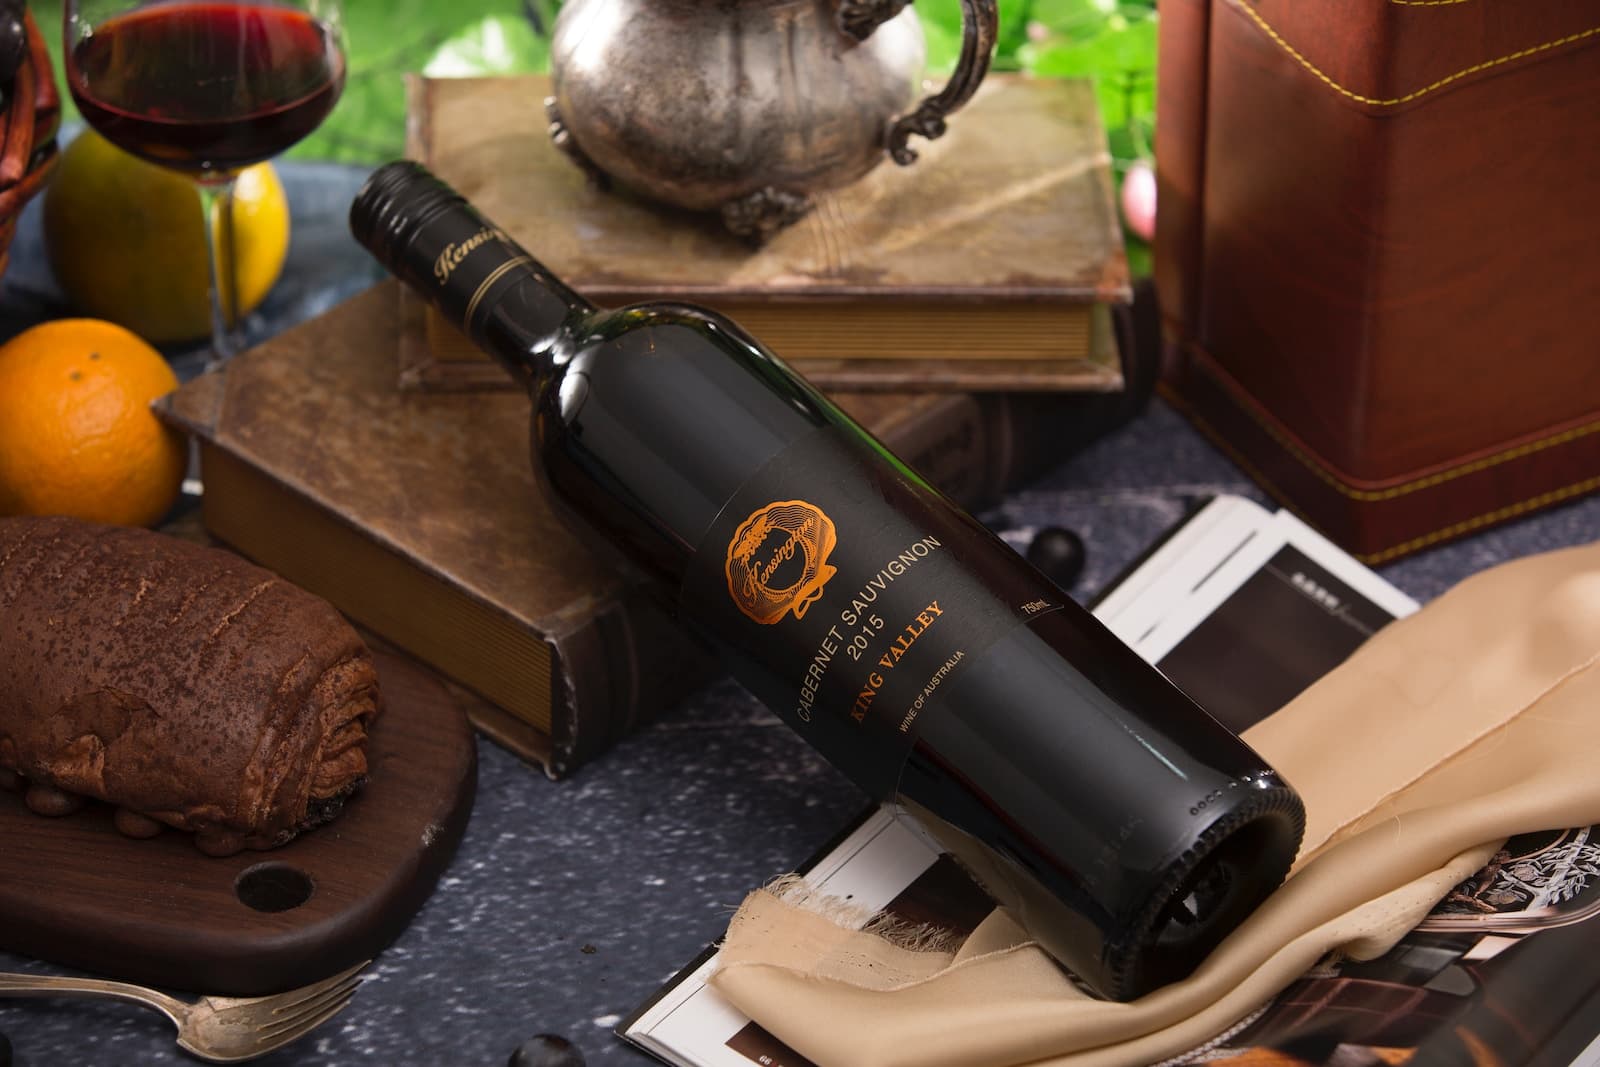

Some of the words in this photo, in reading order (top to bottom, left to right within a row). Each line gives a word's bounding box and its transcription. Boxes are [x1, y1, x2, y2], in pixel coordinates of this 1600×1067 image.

[796, 625, 844, 723] CABERNET
[841, 535, 942, 626] SAUVIGNON
[846, 613, 884, 661] 2015
[851, 672, 884, 722] KING
[879, 600, 944, 669] VALLEY
[899, 707, 918, 733] WINE
[914, 694, 926, 709] OF
[924, 650, 965, 697] AUSTRALIA
